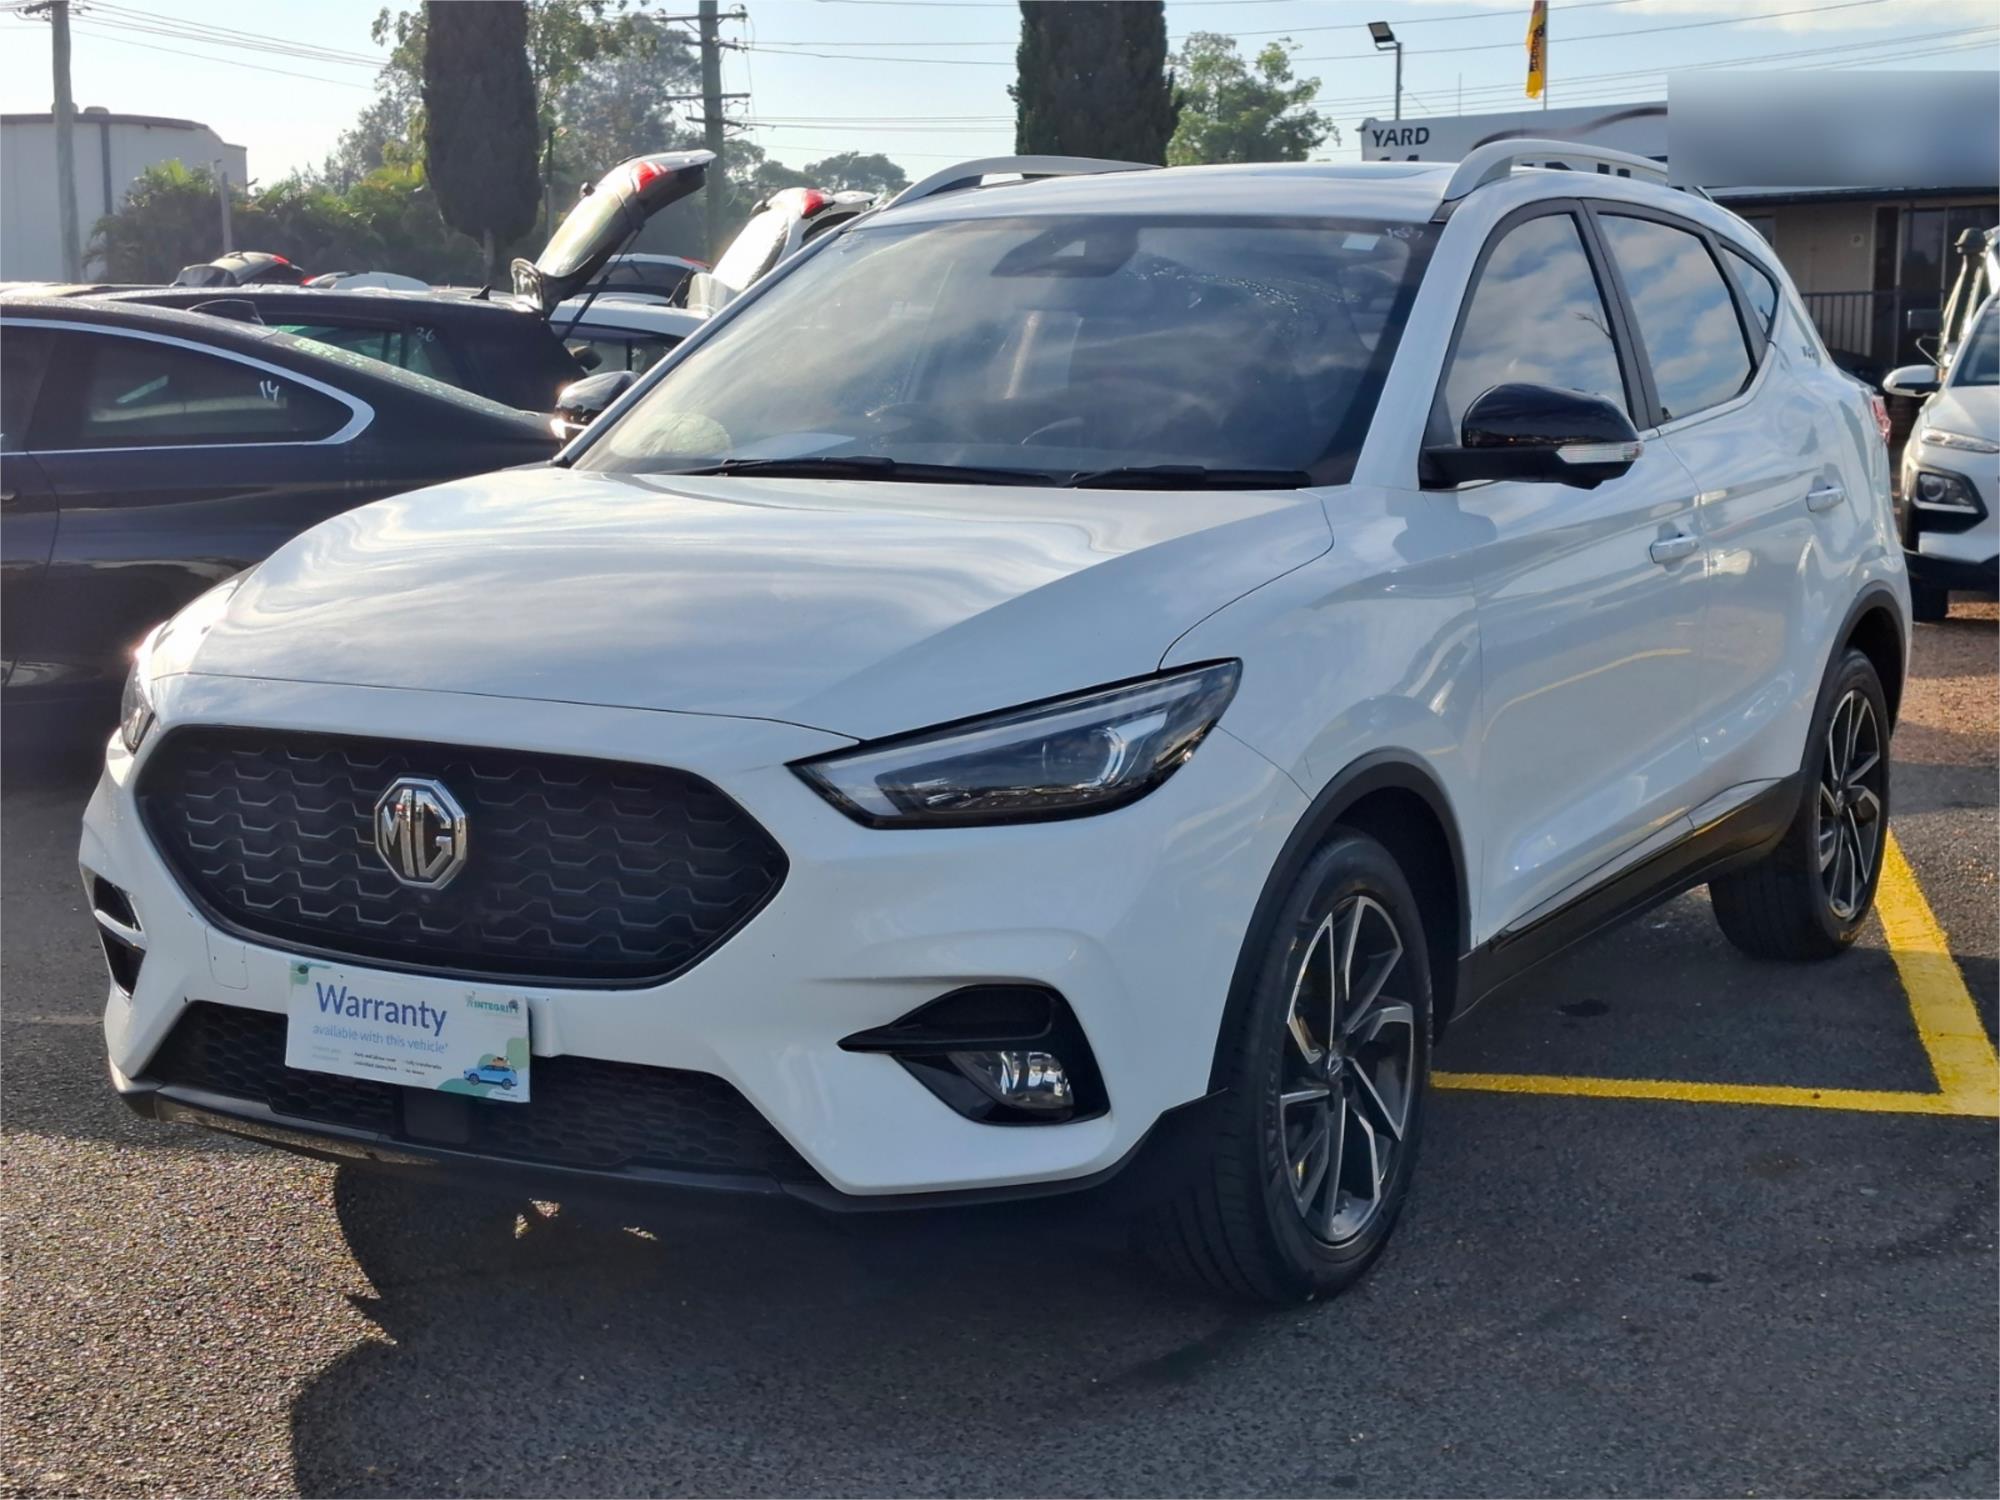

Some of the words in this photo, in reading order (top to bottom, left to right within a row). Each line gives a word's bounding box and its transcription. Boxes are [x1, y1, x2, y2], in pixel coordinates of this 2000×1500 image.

[1372, 126, 1430, 147] YARD
[259, 380, 280, 401] 14
[381, 788, 452, 879] MG
[316, 981, 447, 1037] Warranty
[312, 1024, 358, 1040] available
[359, 1029, 384, 1045] with
[386, 1034, 406, 1048] this
